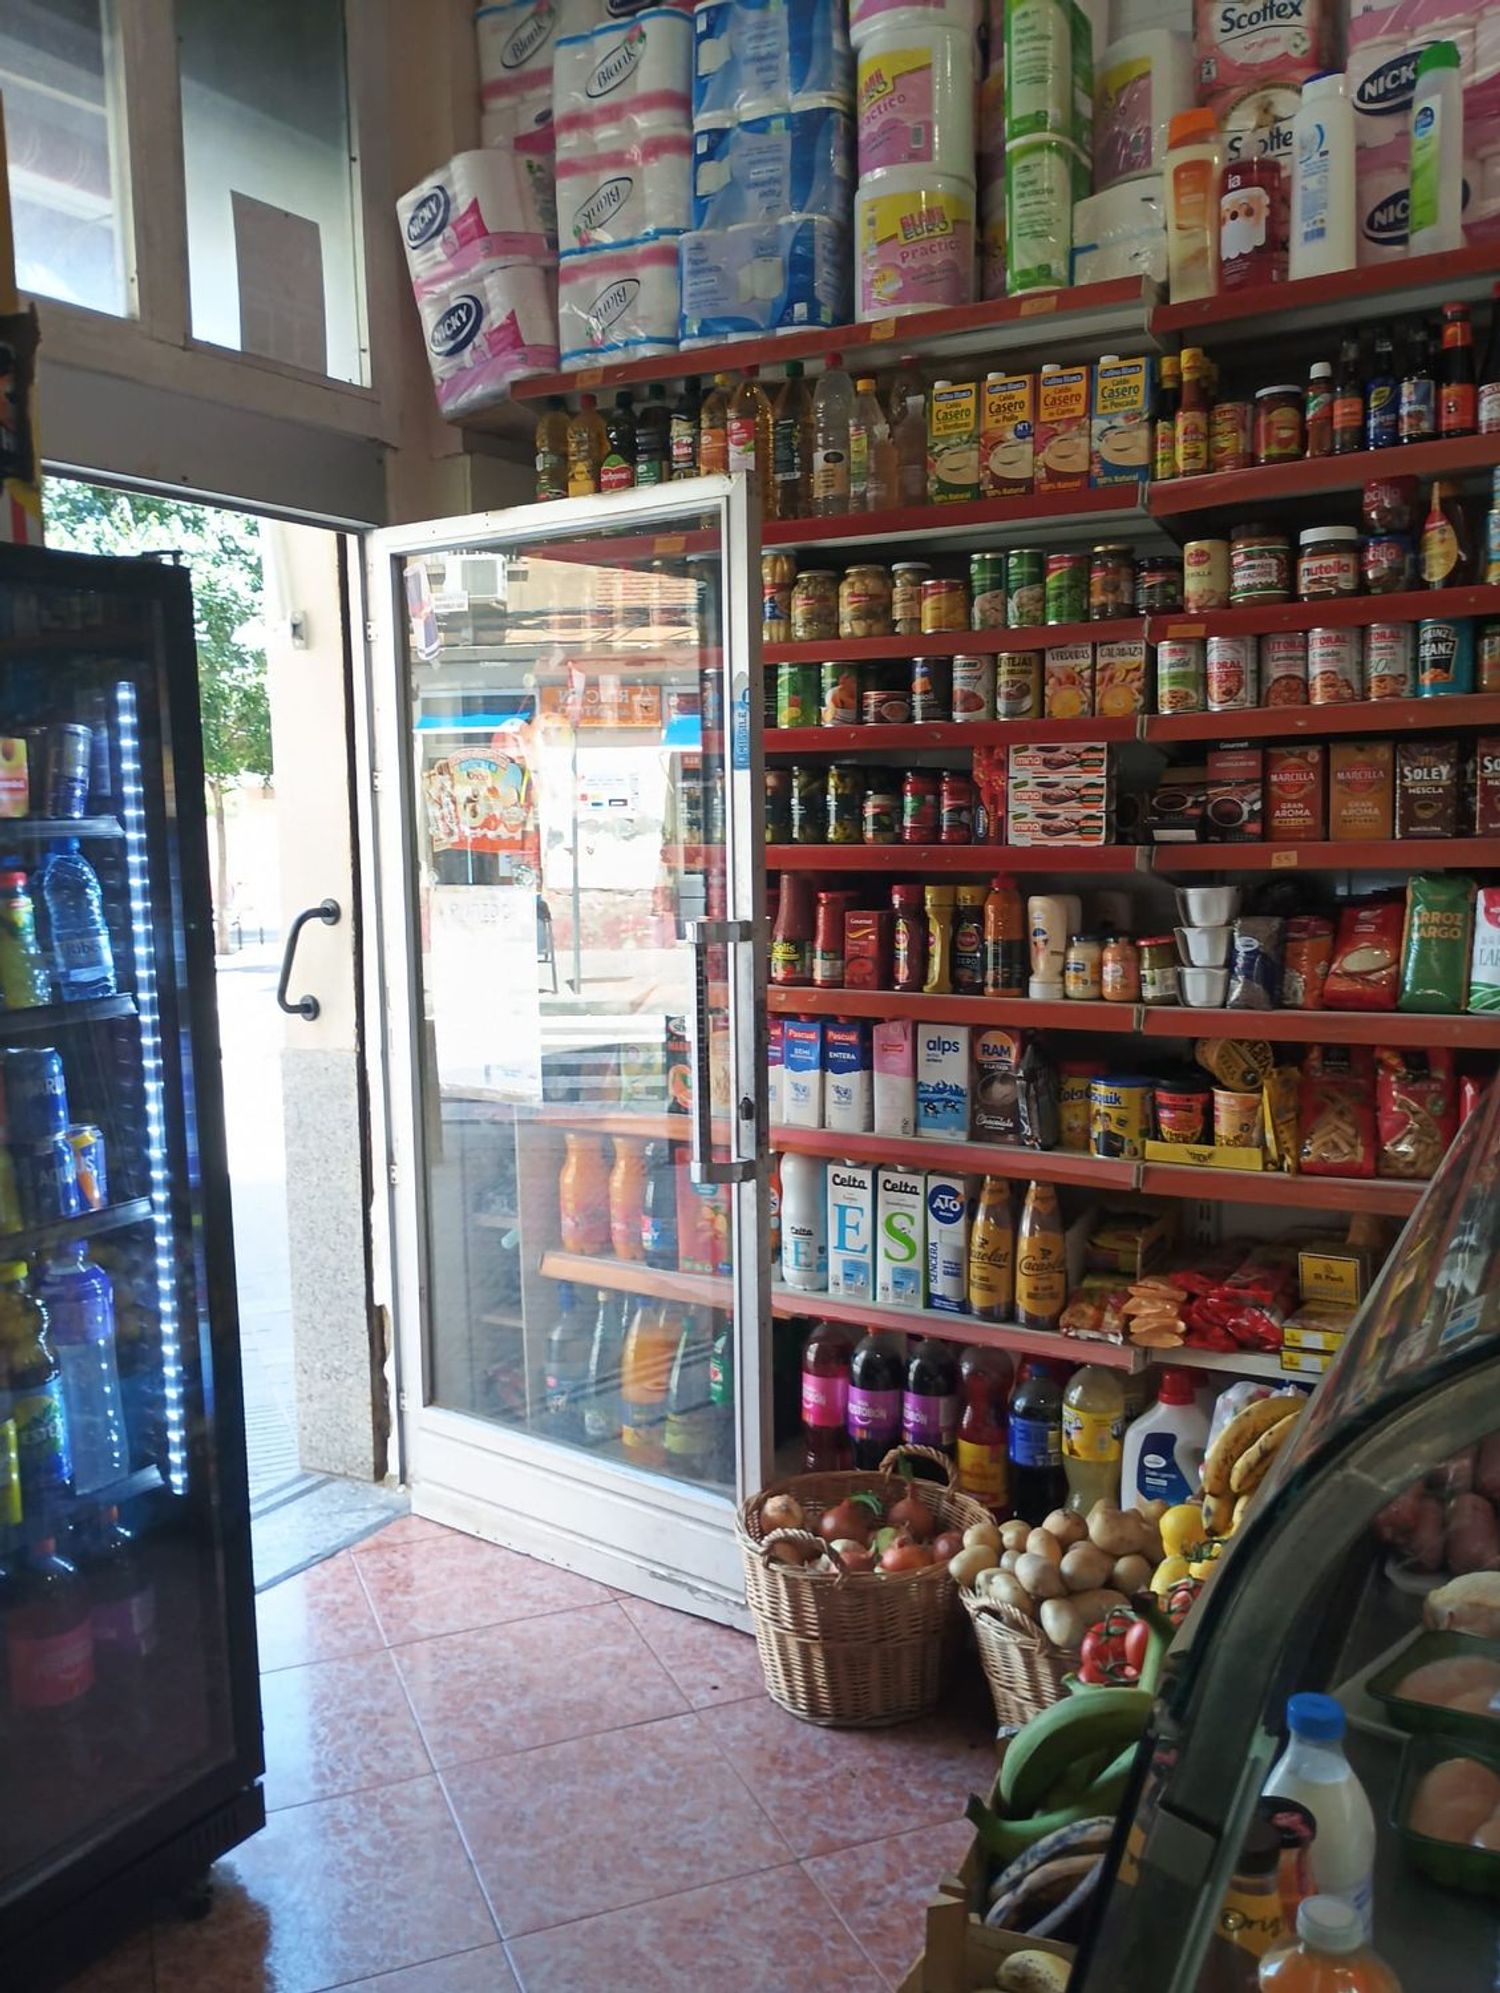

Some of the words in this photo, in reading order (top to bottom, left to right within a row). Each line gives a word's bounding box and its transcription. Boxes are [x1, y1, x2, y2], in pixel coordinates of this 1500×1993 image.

[1220, 0, 1303, 33] Scottex
[597, 44, 638, 89] Blank
[1364, 63, 1415, 101] NICK
[409, 196, 438, 241] NICKY
[1374, 200, 1410, 228] NIC
[433, 304, 468, 346] NICKY
[1101, 385, 1139, 399] Casero
[988, 400, 1025, 415] Casero
[1044, 394, 1081, 407] Casero
[936, 408, 971, 422] Casero
[1303, 559, 1350, 578] nutella
[1421, 627, 1448, 641] HEINZ
[1101, 646, 1143, 659] CALABAZA
[1419, 641, 1453, 657] BEANZ
[1483, 756, 1500, 773] SO
[1271, 773, 1315, 784] MARCILLA
[1336, 770, 1385, 783] MARCILLA
[1403, 765, 1450, 781] SOLEY
[1274, 808, 1312, 818] AROMA
[1341, 807, 1380, 817] AROMA
[1419, 927, 1462, 940] ARGO
[787, 1028, 817, 1040] Pascual
[827, 1030, 858, 1042] Pascual
[926, 1035, 960, 1056] alps
[981, 1043, 1012, 1057] RAM
[828, 1051, 857, 1060] ENTERA
[832, 1173, 868, 1190] Celta
[882, 1179, 920, 1196] Celta
[932, 1194, 960, 1212] ATO
[790, 1226, 814, 1236] Celta
[833, 1202, 868, 1255] E
[883, 1211, 918, 1263] S
[793, 1239, 813, 1268] E
[929, 1242, 938, 1284] SENCERA
